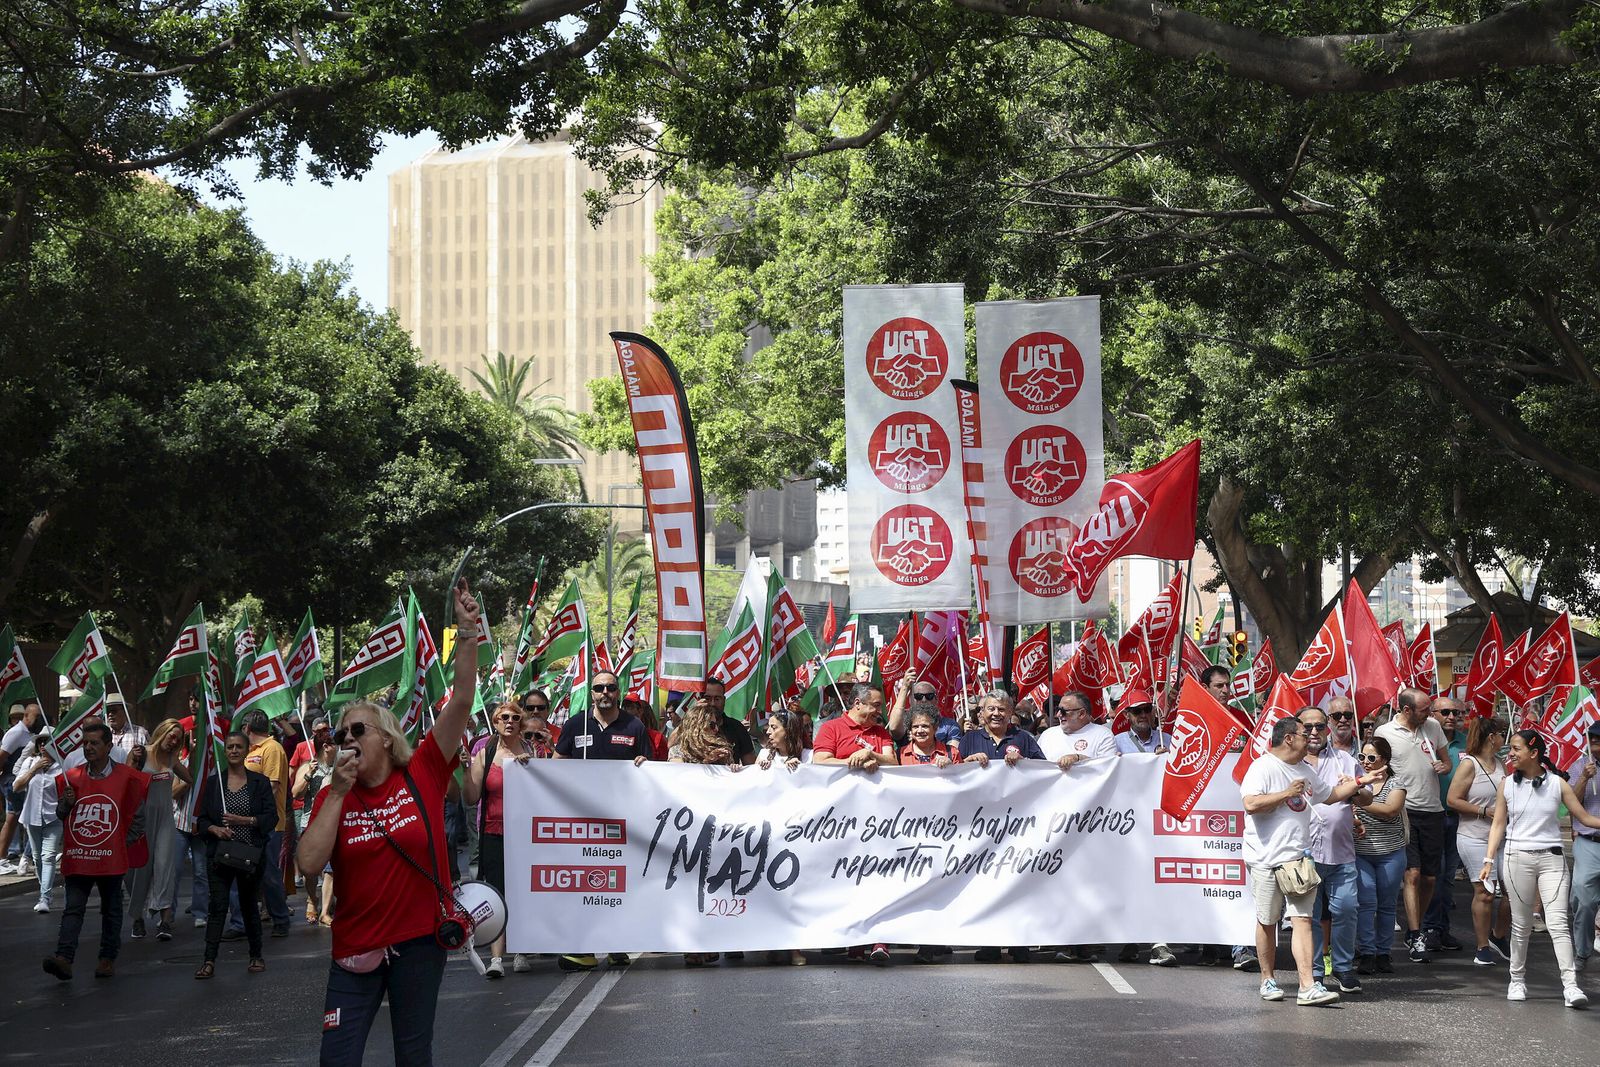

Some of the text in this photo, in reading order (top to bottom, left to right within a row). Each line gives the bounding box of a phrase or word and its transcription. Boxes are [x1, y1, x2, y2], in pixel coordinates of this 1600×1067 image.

[883, 330, 929, 359] UGT
[1018, 344, 1064, 375] UGT
[892, 389, 925, 398] Málaga
[1026, 402, 1060, 411] Málaga
[885, 423, 932, 452] UGT
[1021, 436, 1068, 467] UGT
[893, 482, 927, 491] Málaga
[1030, 495, 1063, 504] Málaga
[887, 516, 934, 545] UGT
[1025, 527, 1071, 557] UGT
[896, 574, 929, 583] Málaga
[1033, 585, 1067, 594] Málaga
[1020, 644, 1047, 674] UGT
[75, 803, 112, 823] UGT
[718, 822, 748, 843] DE
[968, 805, 1036, 845] bajar
[1046, 805, 1136, 843] precios
[1162, 814, 1205, 832] UGT
[582, 846, 622, 859] Málaga
[1203, 840, 1242, 852] Málaga
[664, 814, 801, 913] MAYO
[831, 843, 1063, 886] repartir beneficios
[540, 869, 585, 888] UGT
[583, 895, 622, 908] Málaga
[1203, 887, 1242, 900] Málaga
[706, 898, 747, 917] 2023
